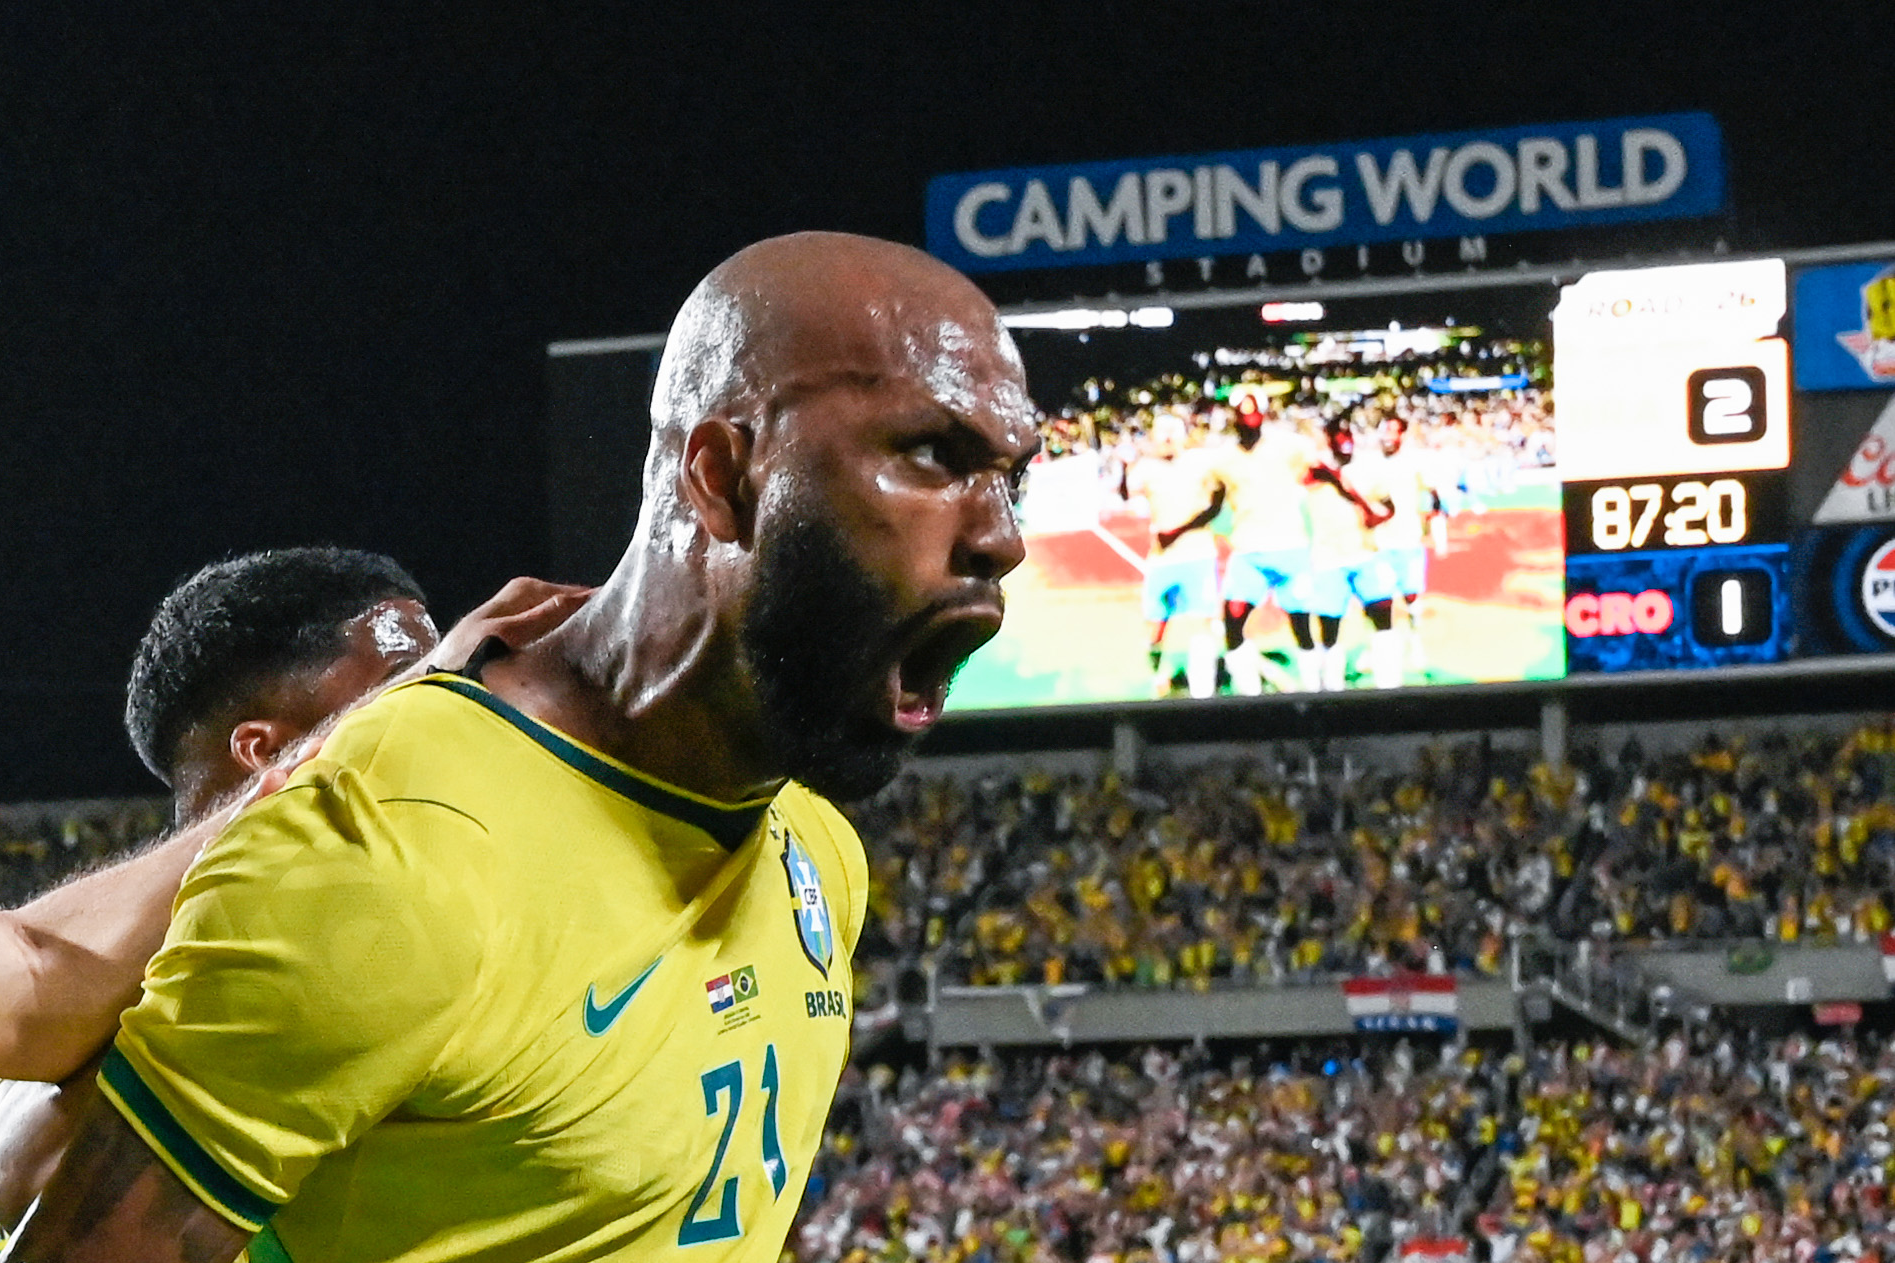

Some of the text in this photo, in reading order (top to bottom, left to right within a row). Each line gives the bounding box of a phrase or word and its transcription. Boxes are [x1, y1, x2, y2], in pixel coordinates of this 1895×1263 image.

[954, 128, 1688, 258] CAMPING WORLD
[1145, 235, 1487, 287] STADIUM
[1702, 377, 1754, 436] 2
[1564, 588, 1675, 638] CRO
[677, 1042, 789, 1248] 21
